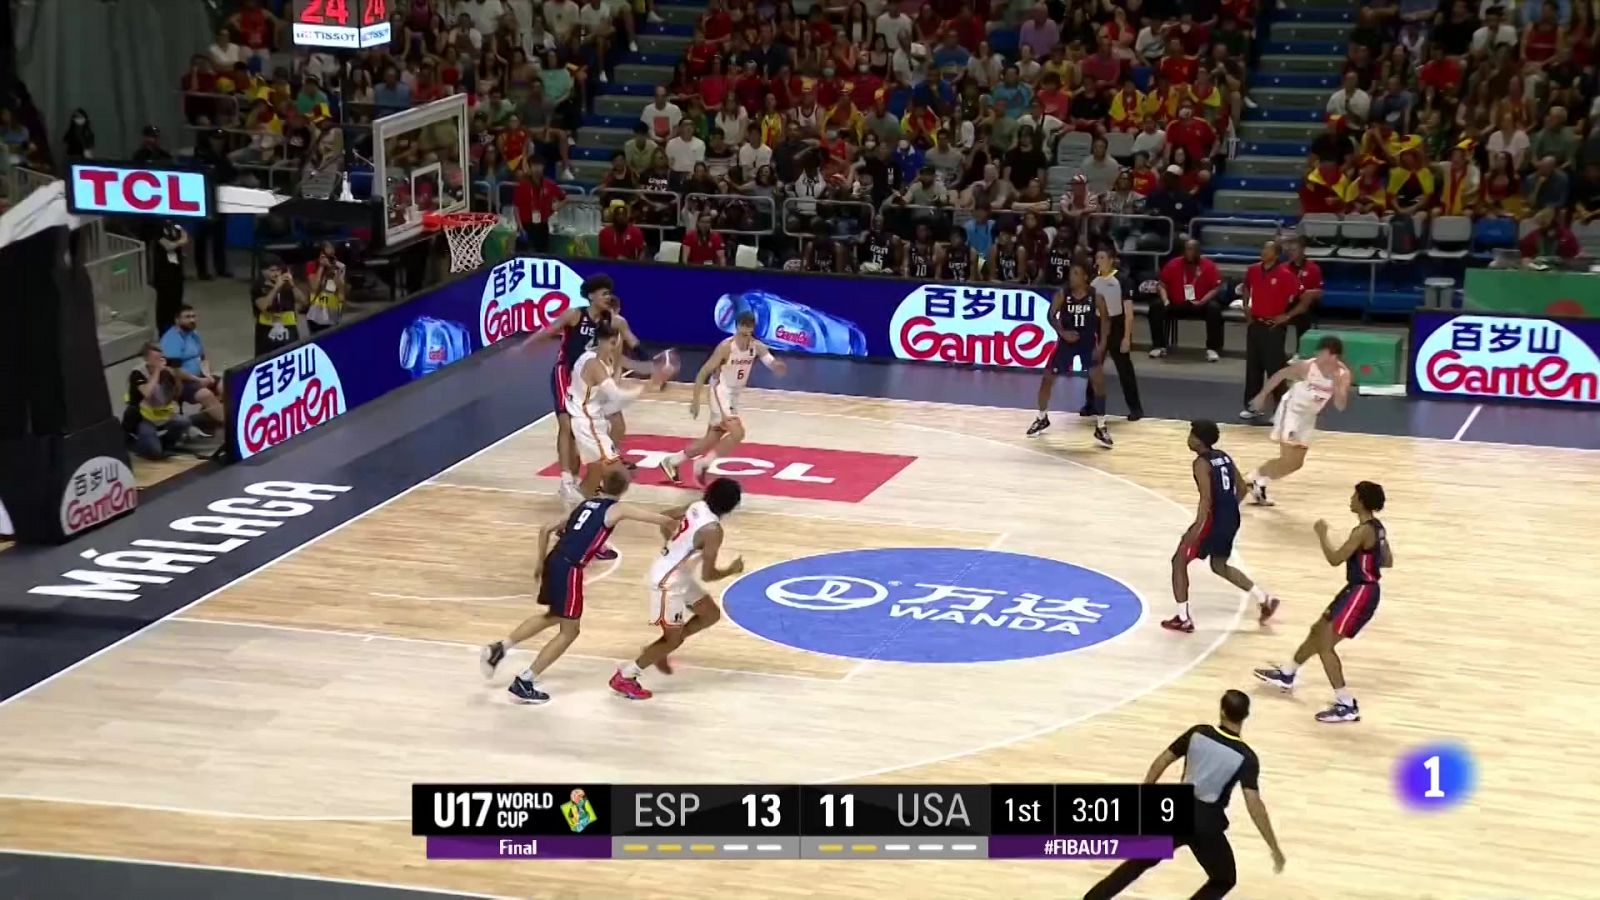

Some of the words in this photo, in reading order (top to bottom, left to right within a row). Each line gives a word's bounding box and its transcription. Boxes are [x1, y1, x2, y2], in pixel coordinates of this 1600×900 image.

[301, 0, 349, 26] 24
[313, 31, 356, 41] TISSOT
[79, 170, 200, 211] TCL
[1050, 257, 1071, 266] USA
[1056, 267, 1063, 280] 5
[493, 260, 561, 299] 百岁山
[484, 291, 570, 343] Gante
[924, 287, 1035, 321] 百岁山
[1067, 304, 1091, 313] USA
[1073, 313, 1085, 327] 11
[900, 315, 1057, 367] Gante
[1452, 322, 1561, 354] 百岁山
[256, 348, 316, 401] 百岁山
[75, 463, 118, 496] 百岁山
[627, 449, 836, 484] TCL
[1220, 466, 1230, 490] 6
[573, 509, 592, 530] 9
[27, 480, 353, 602] MÁLAGA
[898, 583, 1110, 624] 万达
[889, 604, 1081, 636] WANDA
